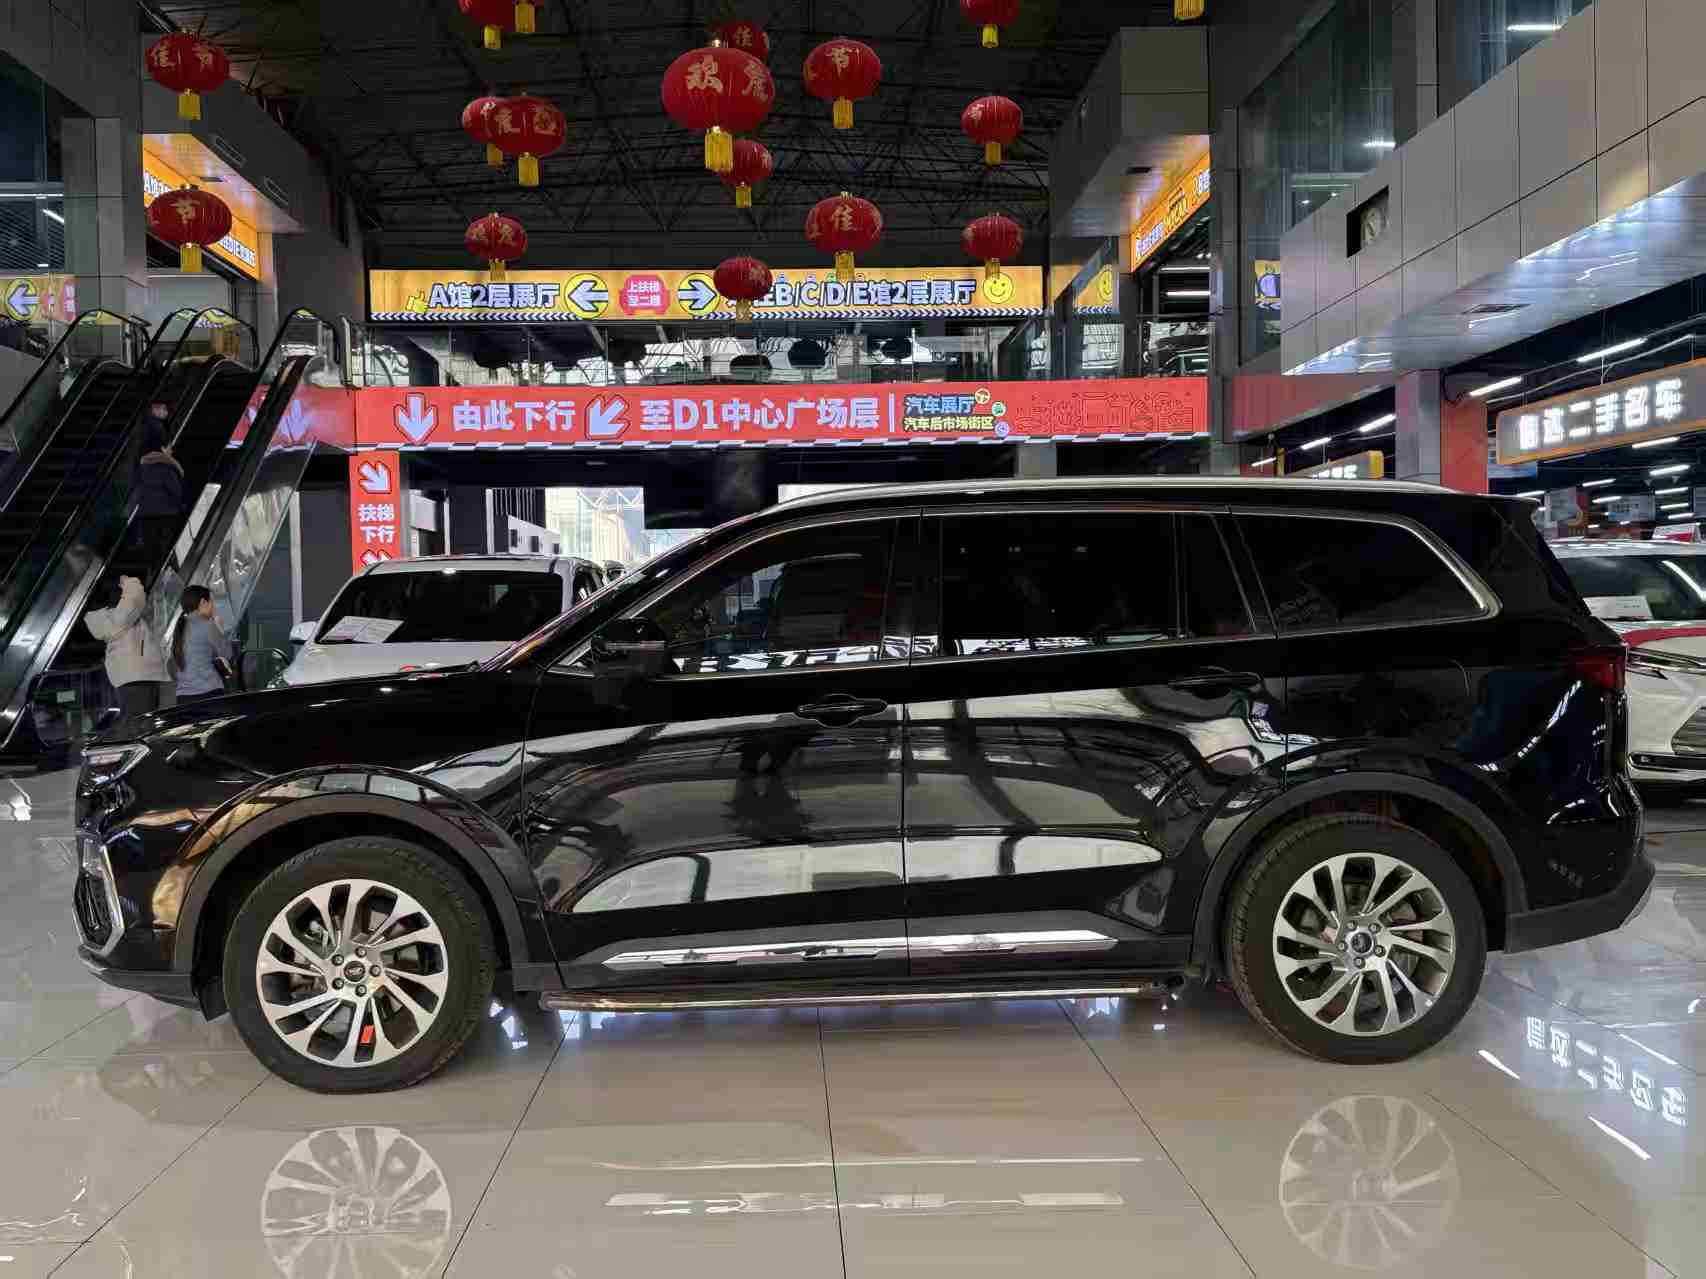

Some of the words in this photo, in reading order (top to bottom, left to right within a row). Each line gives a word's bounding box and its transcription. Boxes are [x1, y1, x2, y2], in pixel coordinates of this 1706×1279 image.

[428, 282, 561, 310] A馆2层展厅
[452, 400, 577, 432] 由此下行
[640, 397, 880, 432] 至D1中心广场层
[359, 525, 395, 544] 下行
